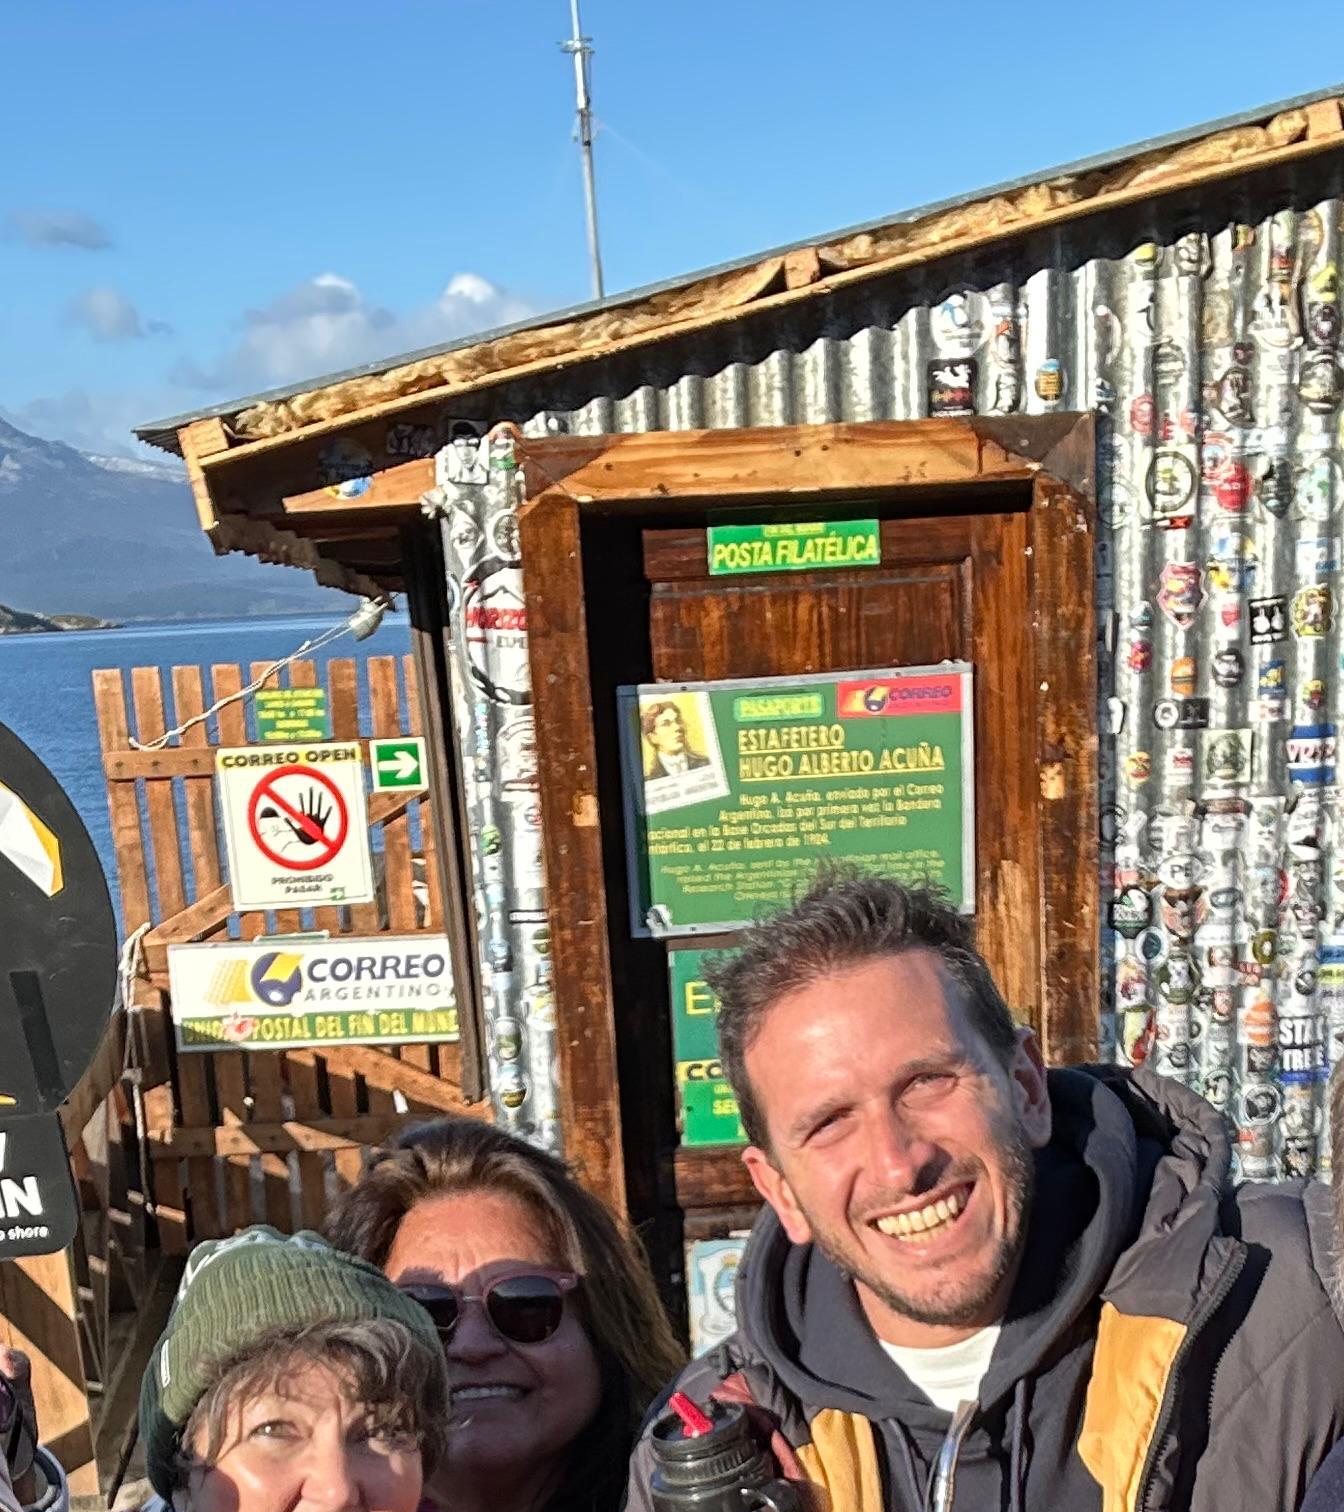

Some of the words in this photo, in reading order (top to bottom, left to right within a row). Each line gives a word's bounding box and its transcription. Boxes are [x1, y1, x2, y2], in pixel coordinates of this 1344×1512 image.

[713, 541, 773, 569] POSTA
[775, 531, 877, 565] FILATÉLICA
[738, 724, 845, 751] ESTAFETERO
[221, 752, 300, 768] CORREO
[305, 748, 356, 763] OPEN
[739, 755, 794, 780] HUGO
[798, 750, 874, 776] ALBERTO
[879, 741, 945, 770] ACUÑA
[307, 953, 446, 983] CORREO
[304, 983, 442, 1003] ARGENTINO
[315, 1014, 345, 1038] DEL
[378, 1012, 408, 1035] DEL
[7, 1226, 49, 1240] shore
